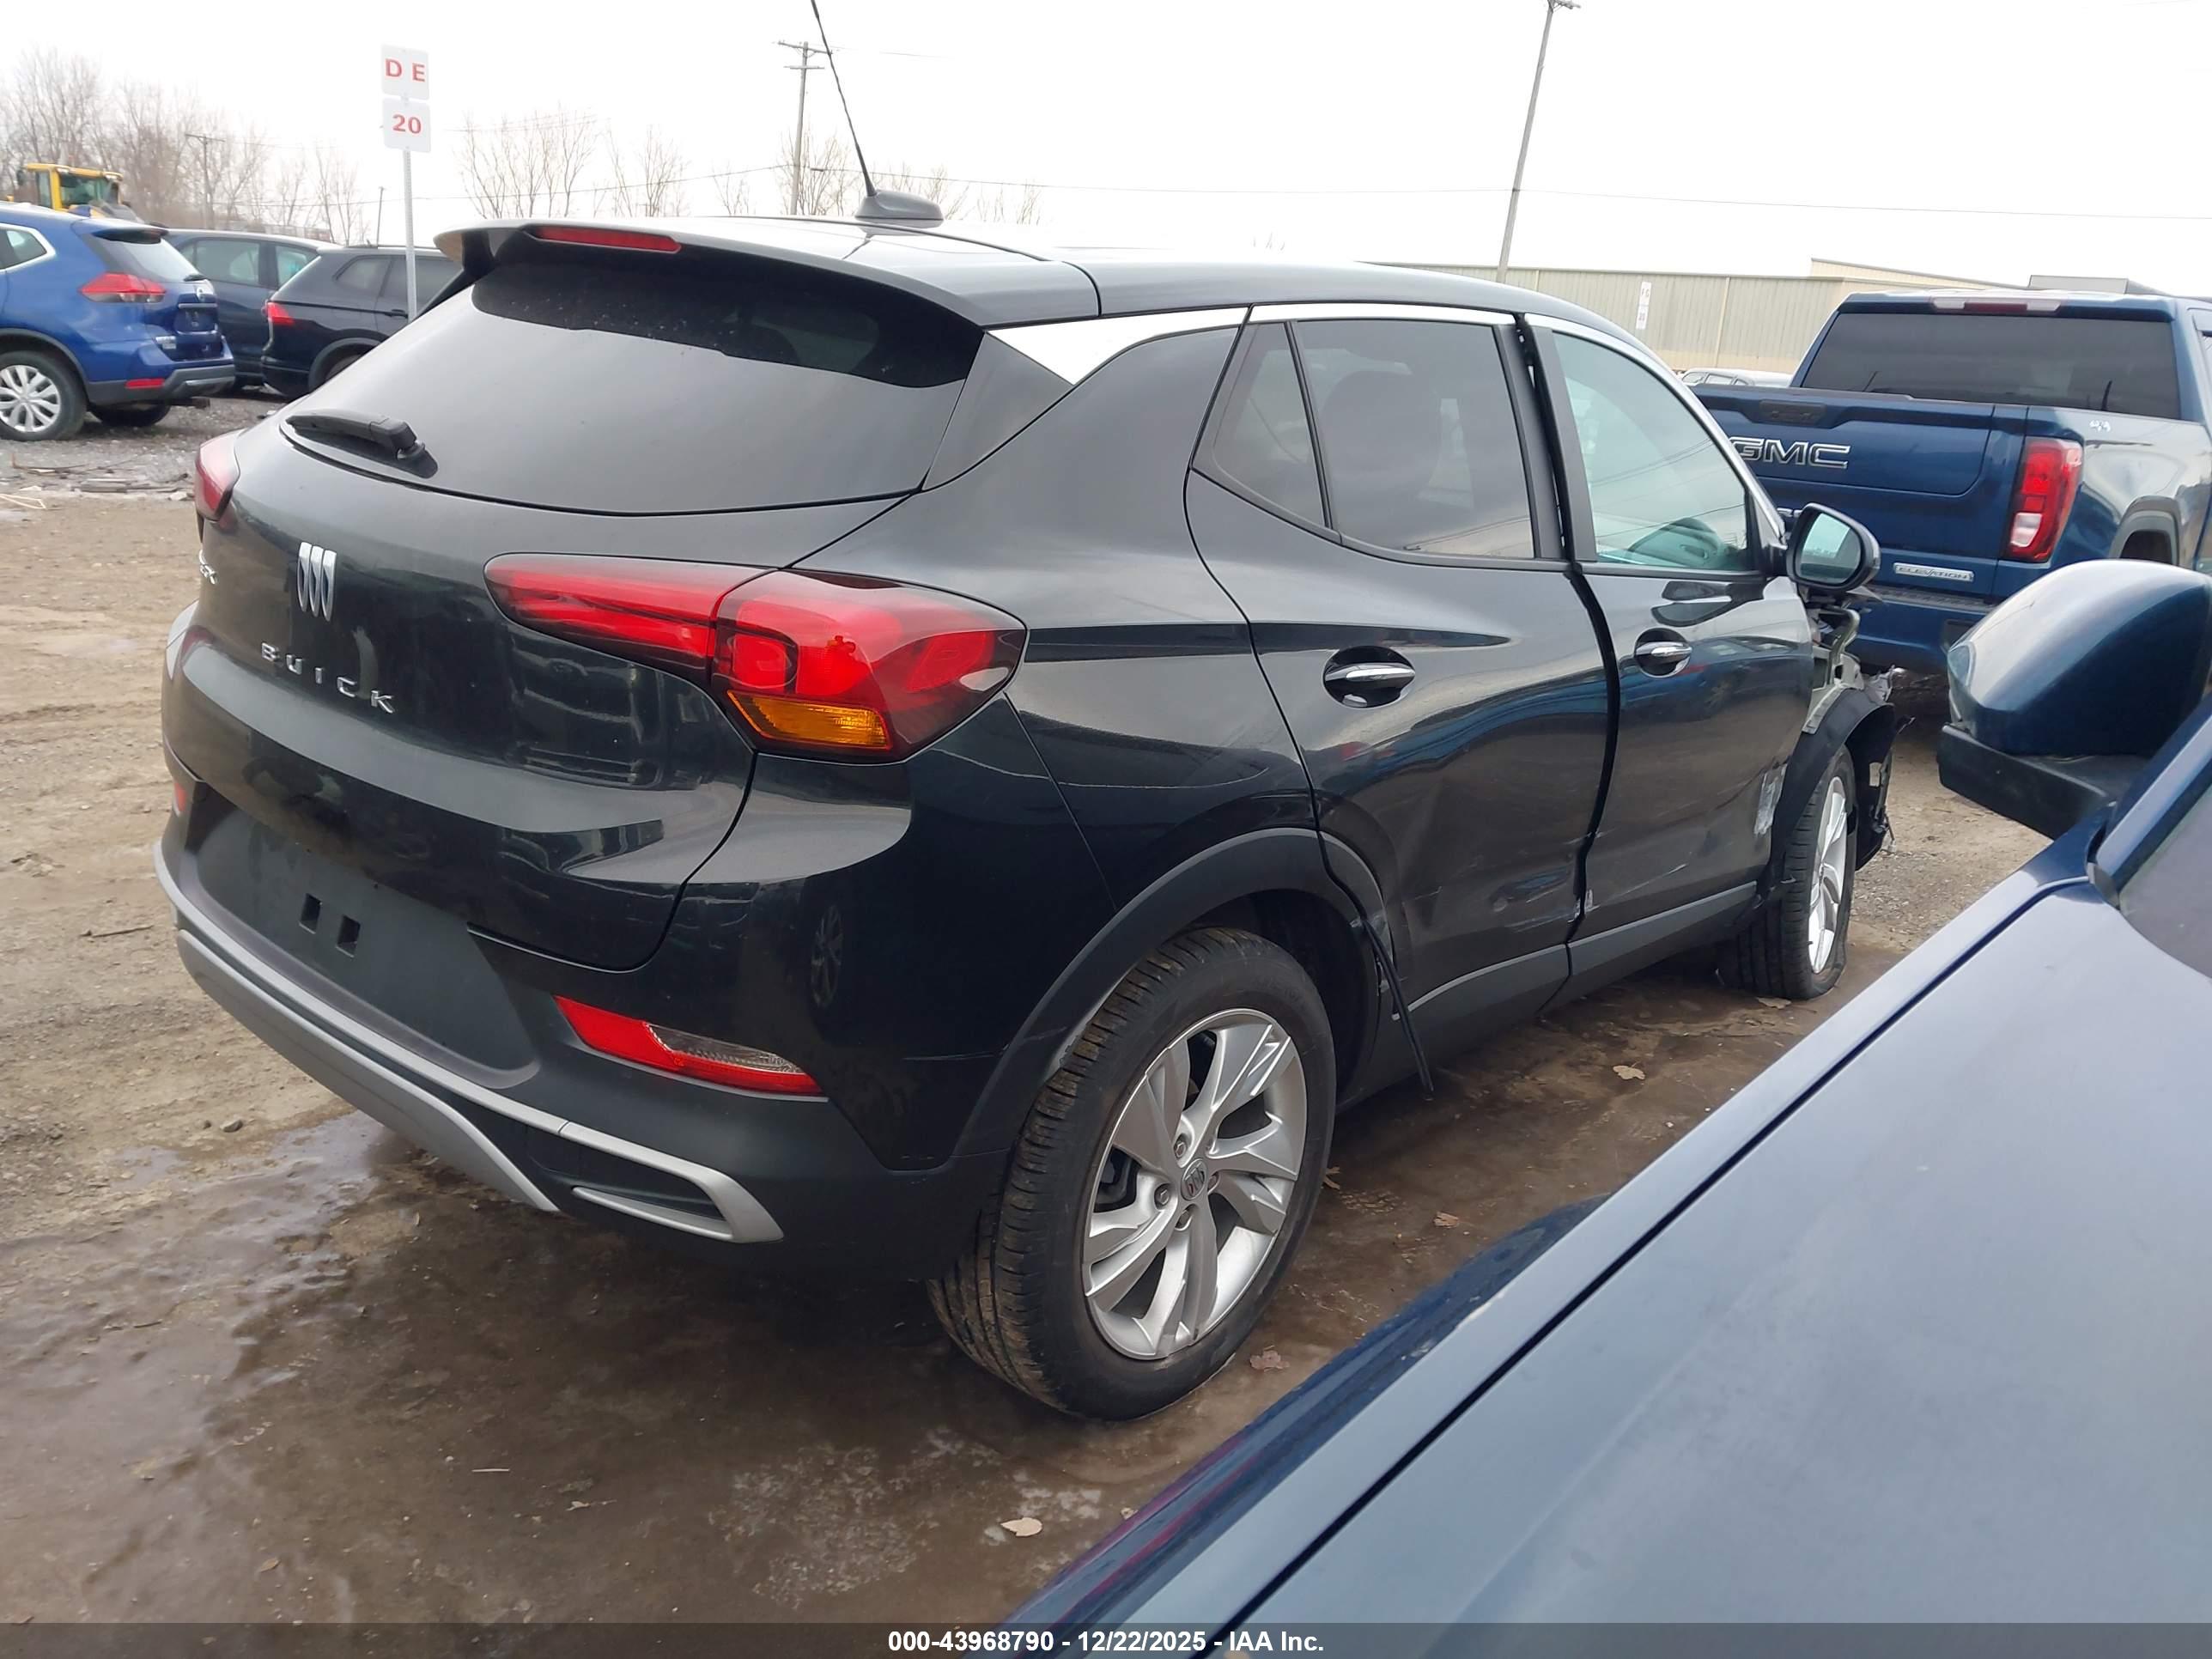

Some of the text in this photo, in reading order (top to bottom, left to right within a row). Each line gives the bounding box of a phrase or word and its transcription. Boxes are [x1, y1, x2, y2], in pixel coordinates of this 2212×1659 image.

[385, 58, 426, 82] D E
[392, 113, 422, 135] 20
[1730, 436, 1851, 470] GMC
[261, 641, 395, 714] BUICK
